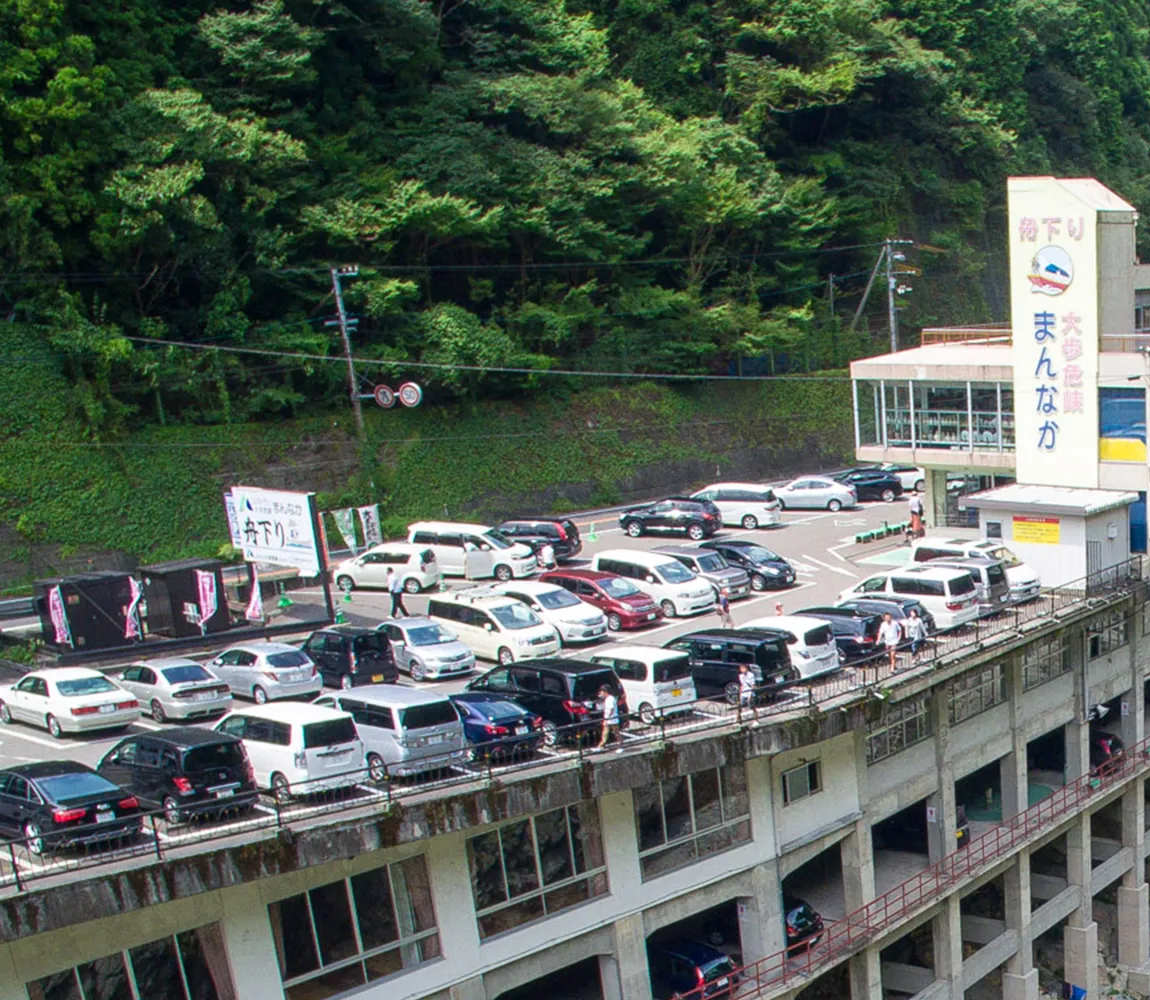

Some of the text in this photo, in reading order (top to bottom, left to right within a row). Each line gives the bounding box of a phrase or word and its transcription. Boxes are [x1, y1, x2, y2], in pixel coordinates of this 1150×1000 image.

[1018, 217, 1084, 242] 舟下り
[1034, 311, 1059, 450] まんなか
[1061, 311, 1084, 414] 大歩危峡
[243, 517, 285, 547] 舟下り
